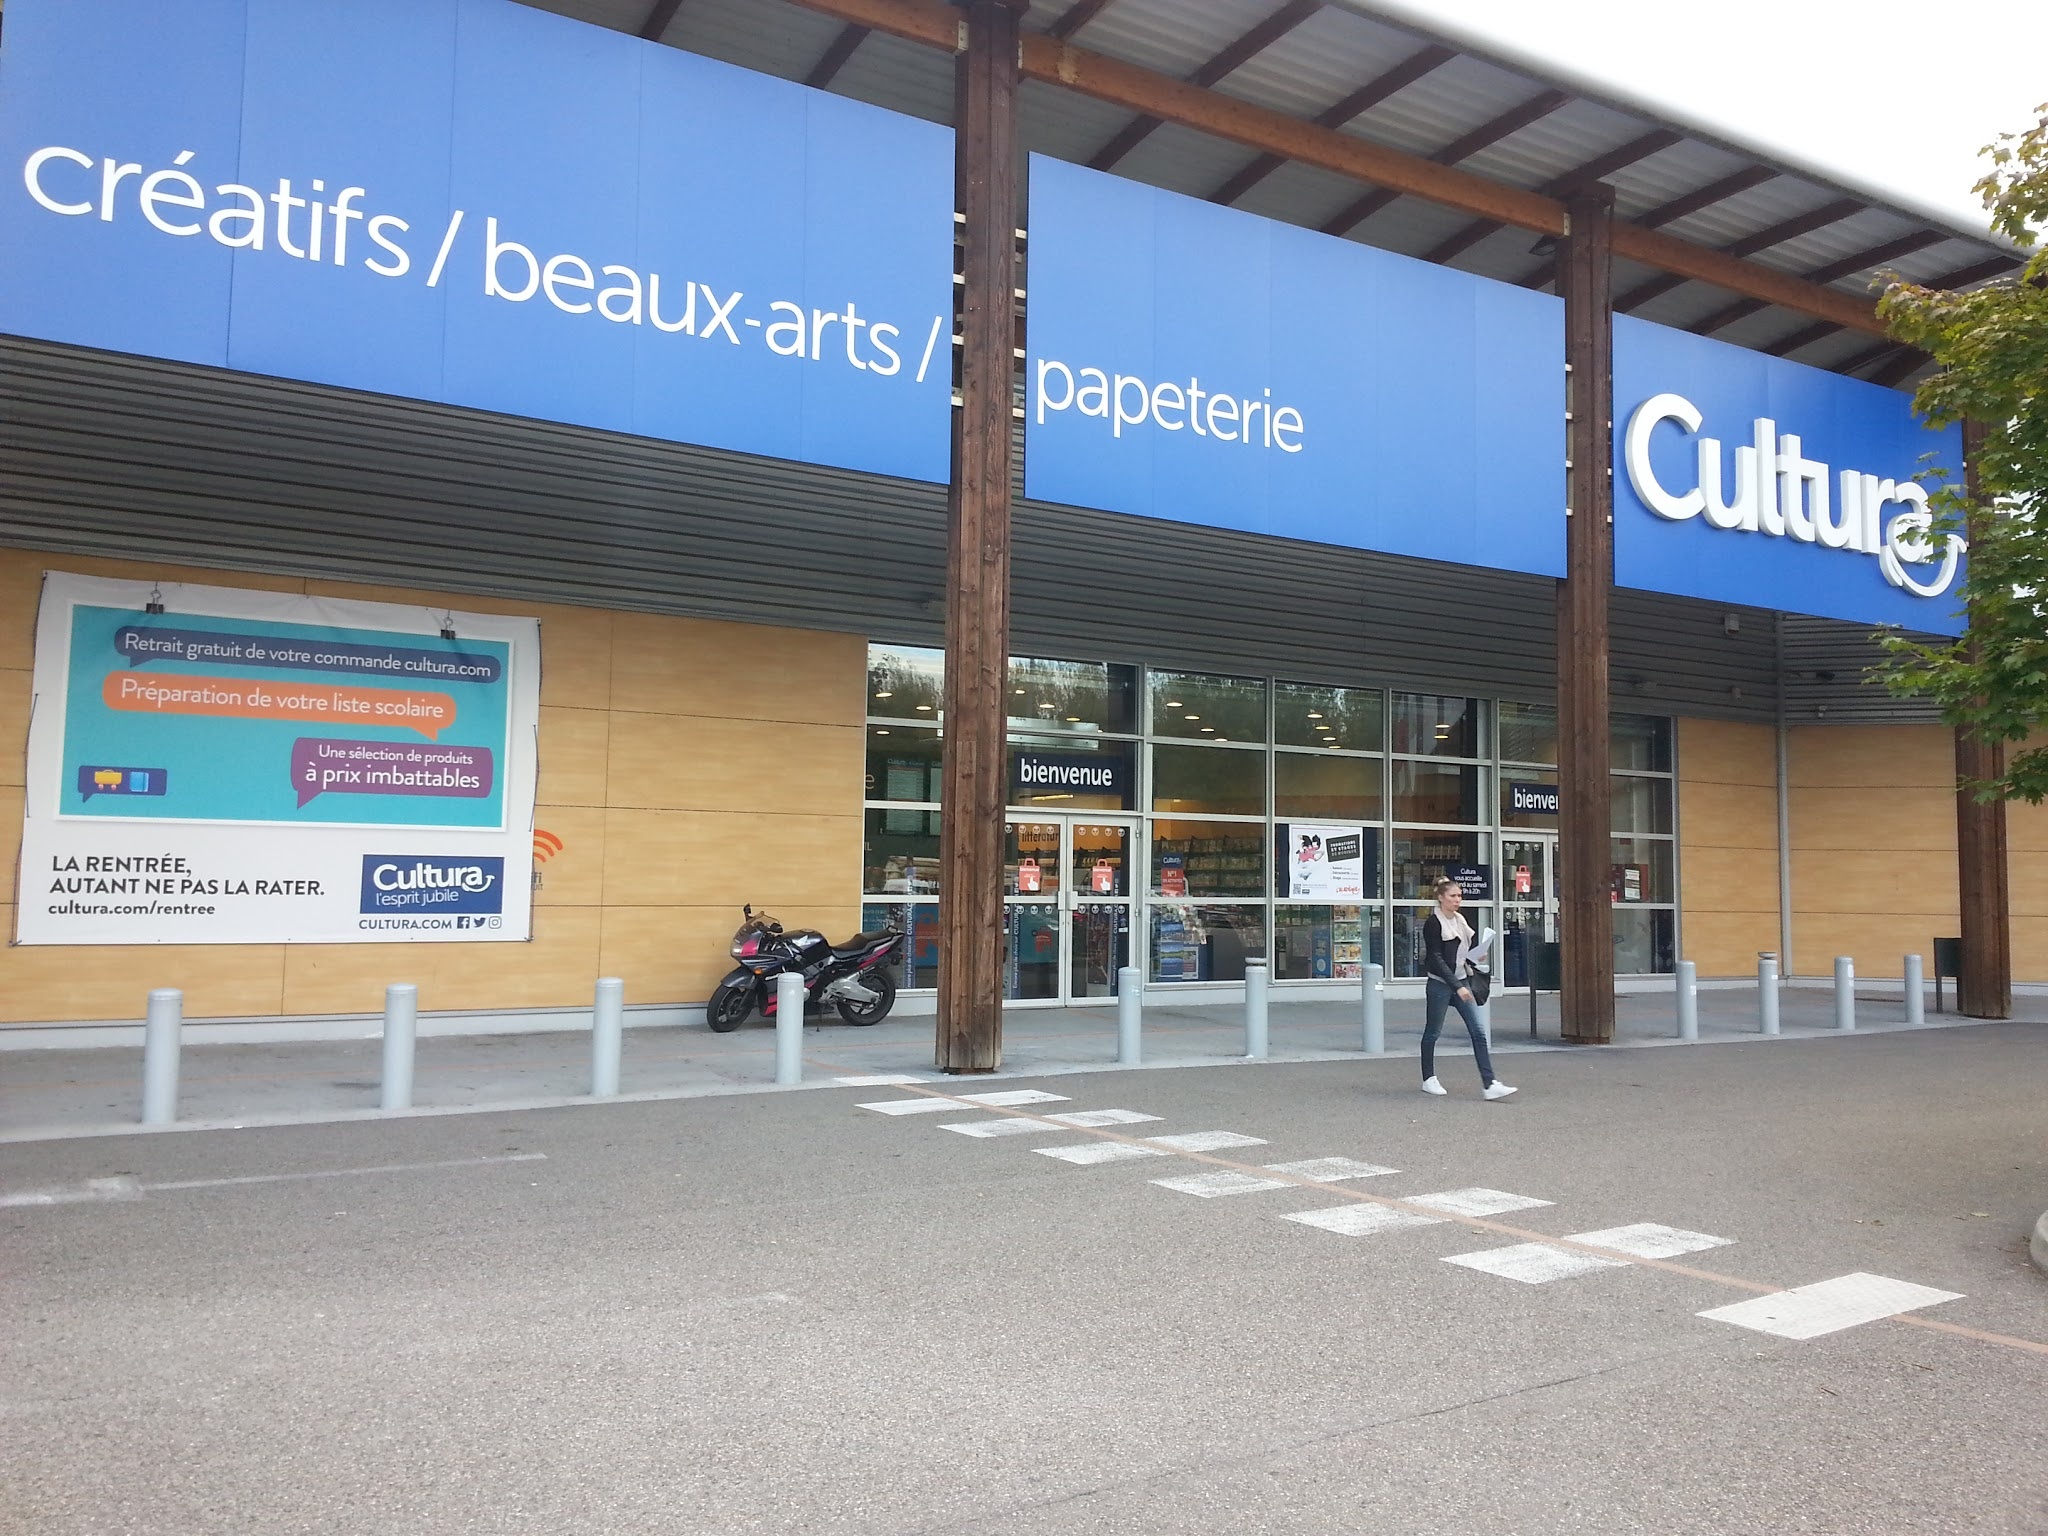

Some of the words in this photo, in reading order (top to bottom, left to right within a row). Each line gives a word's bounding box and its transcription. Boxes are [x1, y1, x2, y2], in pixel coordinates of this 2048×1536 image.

[24, 146, 411, 277] créatifs
[426, 210, 464, 288] /
[485, 217, 901, 376] beaux-arts
[916, 316, 943, 383] /
[1037, 358, 1304, 453] papeterie
[1625, 393, 1966, 598] Cultura
[125, 633, 183, 653] Retrait
[187, 642, 241, 660] gratuit
[246, 643, 266, 659] de
[269, 649, 310, 663] votre
[315, 654, 401, 670] commande
[404, 657, 491, 676] cultura.com
[121, 678, 241, 708] Préparation
[248, 687, 271, 707] de
[277, 693, 328, 710] votre
[333, 693, 371, 713] liste
[375, 698, 443, 718] scolaire
[319, 745, 345, 758] Une
[349, 746, 403, 761] sélection
[407, 749, 422, 762] de
[424, 752, 473, 766] produits
[305, 762, 317, 782] à
[323, 763, 360, 789] prix
[366, 765, 480, 788] imbattables
[1021, 758, 1113, 787] bienvenue
[52, 856, 80, 872] LA
[86, 853, 192, 877] RENTRÉE,
[373, 863, 495, 892] Cultura
[49, 878, 140, 894] AUTANT
[145, 879, 175, 894] NE
[180, 879, 218, 895] PAS
[224, 880, 250, 895] LA
[255, 880, 325, 896] RATER.
[376, 891, 420, 907] l'esprit
[421, 890, 459, 906] jubile
[49, 900, 215, 915] cultura.com/rentree
[359, 919, 452, 929] CULTURA.COM
